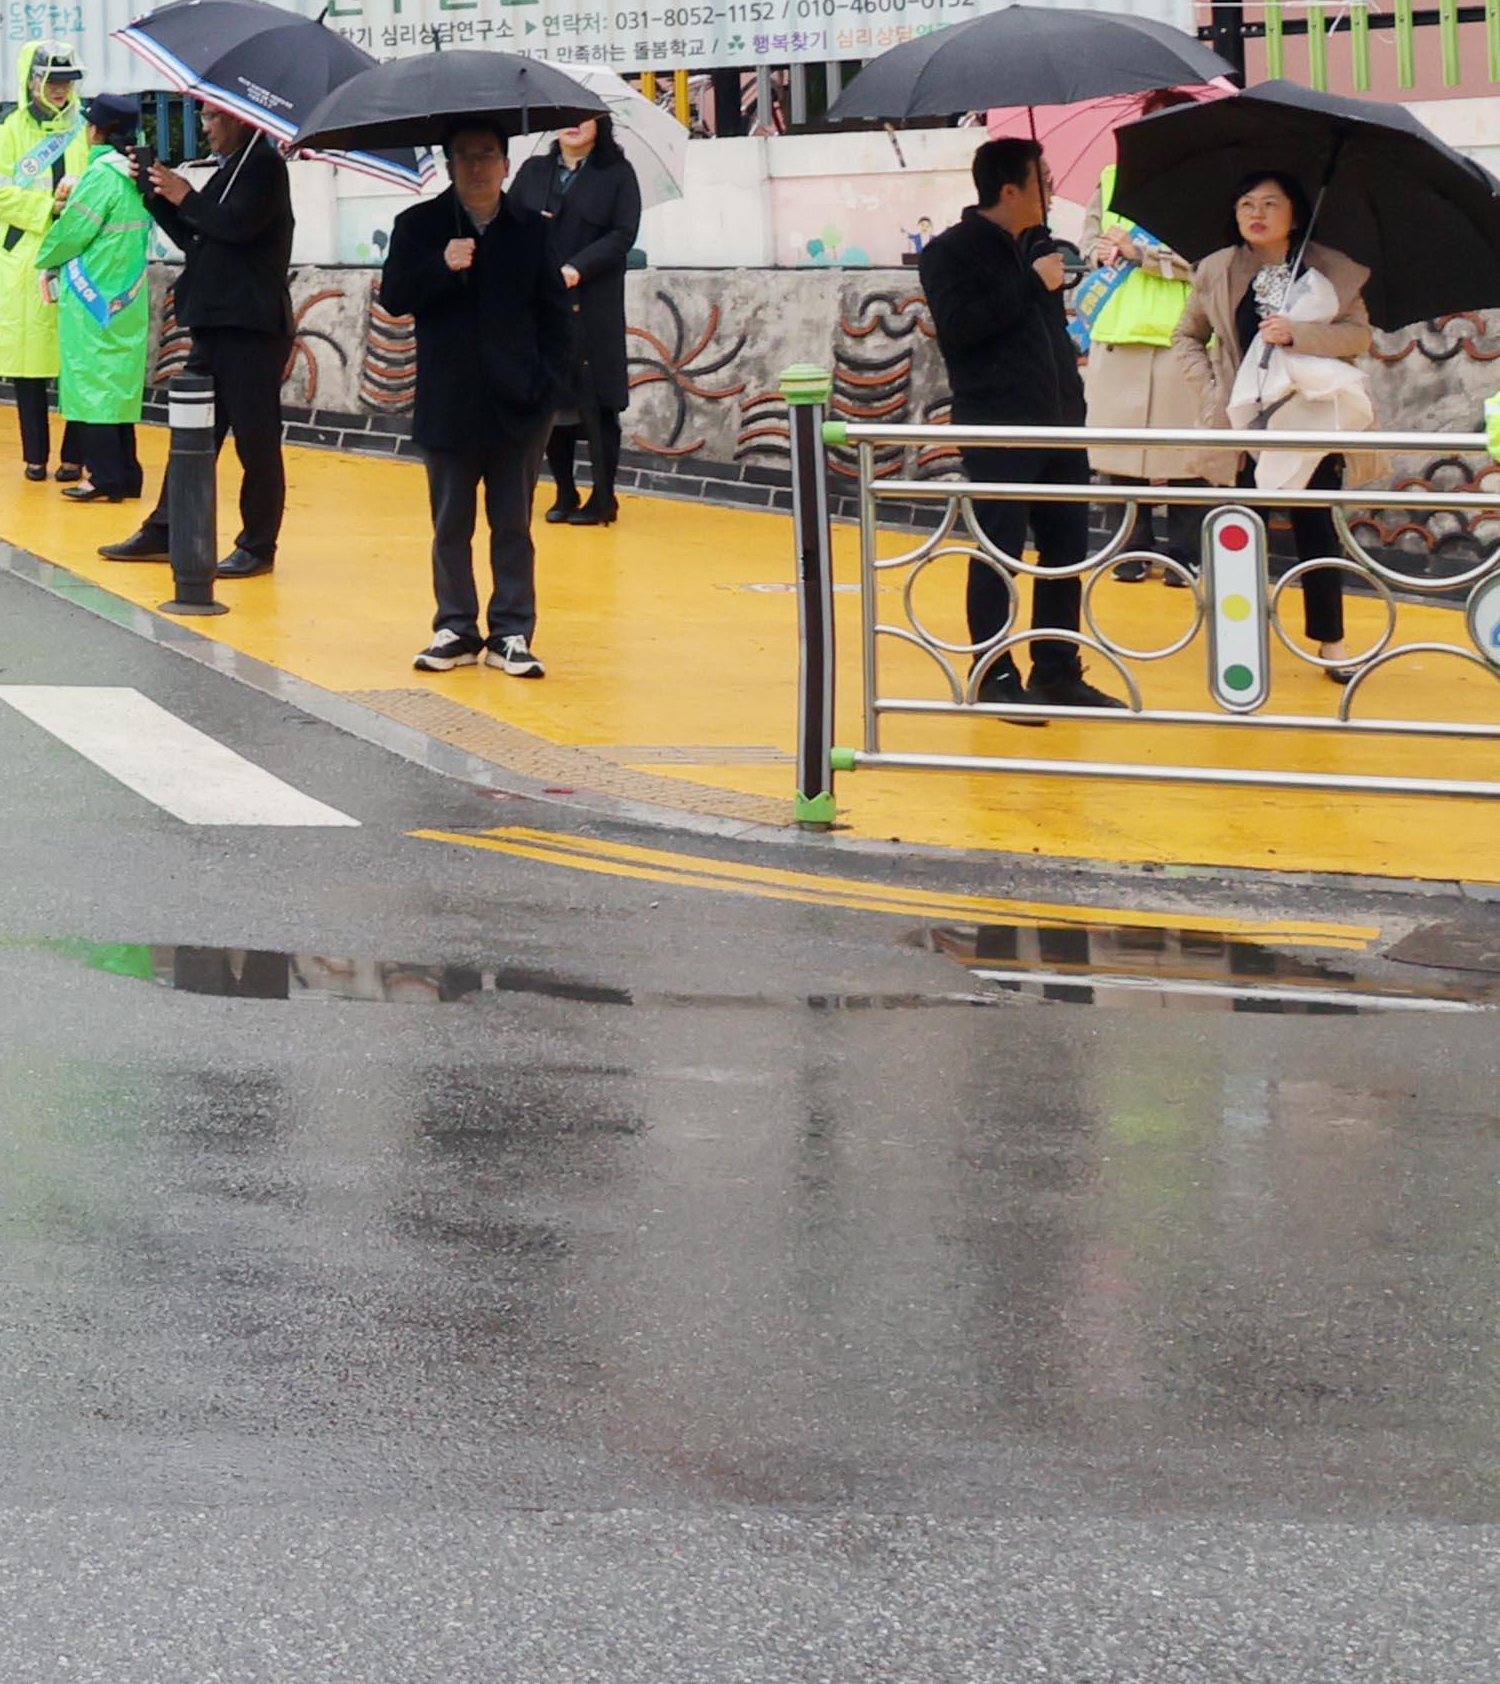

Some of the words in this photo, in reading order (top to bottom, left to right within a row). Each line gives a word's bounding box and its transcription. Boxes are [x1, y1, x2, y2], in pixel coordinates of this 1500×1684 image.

[10, 2, 86, 41] 돌봄학교
[615, 1, 774, 30] 031-8052-1152
[556, 44, 627, 63] 만족하는
[633, 38, 706, 60] 돌봄학교
[752, 31, 829, 55] 행복찾기
